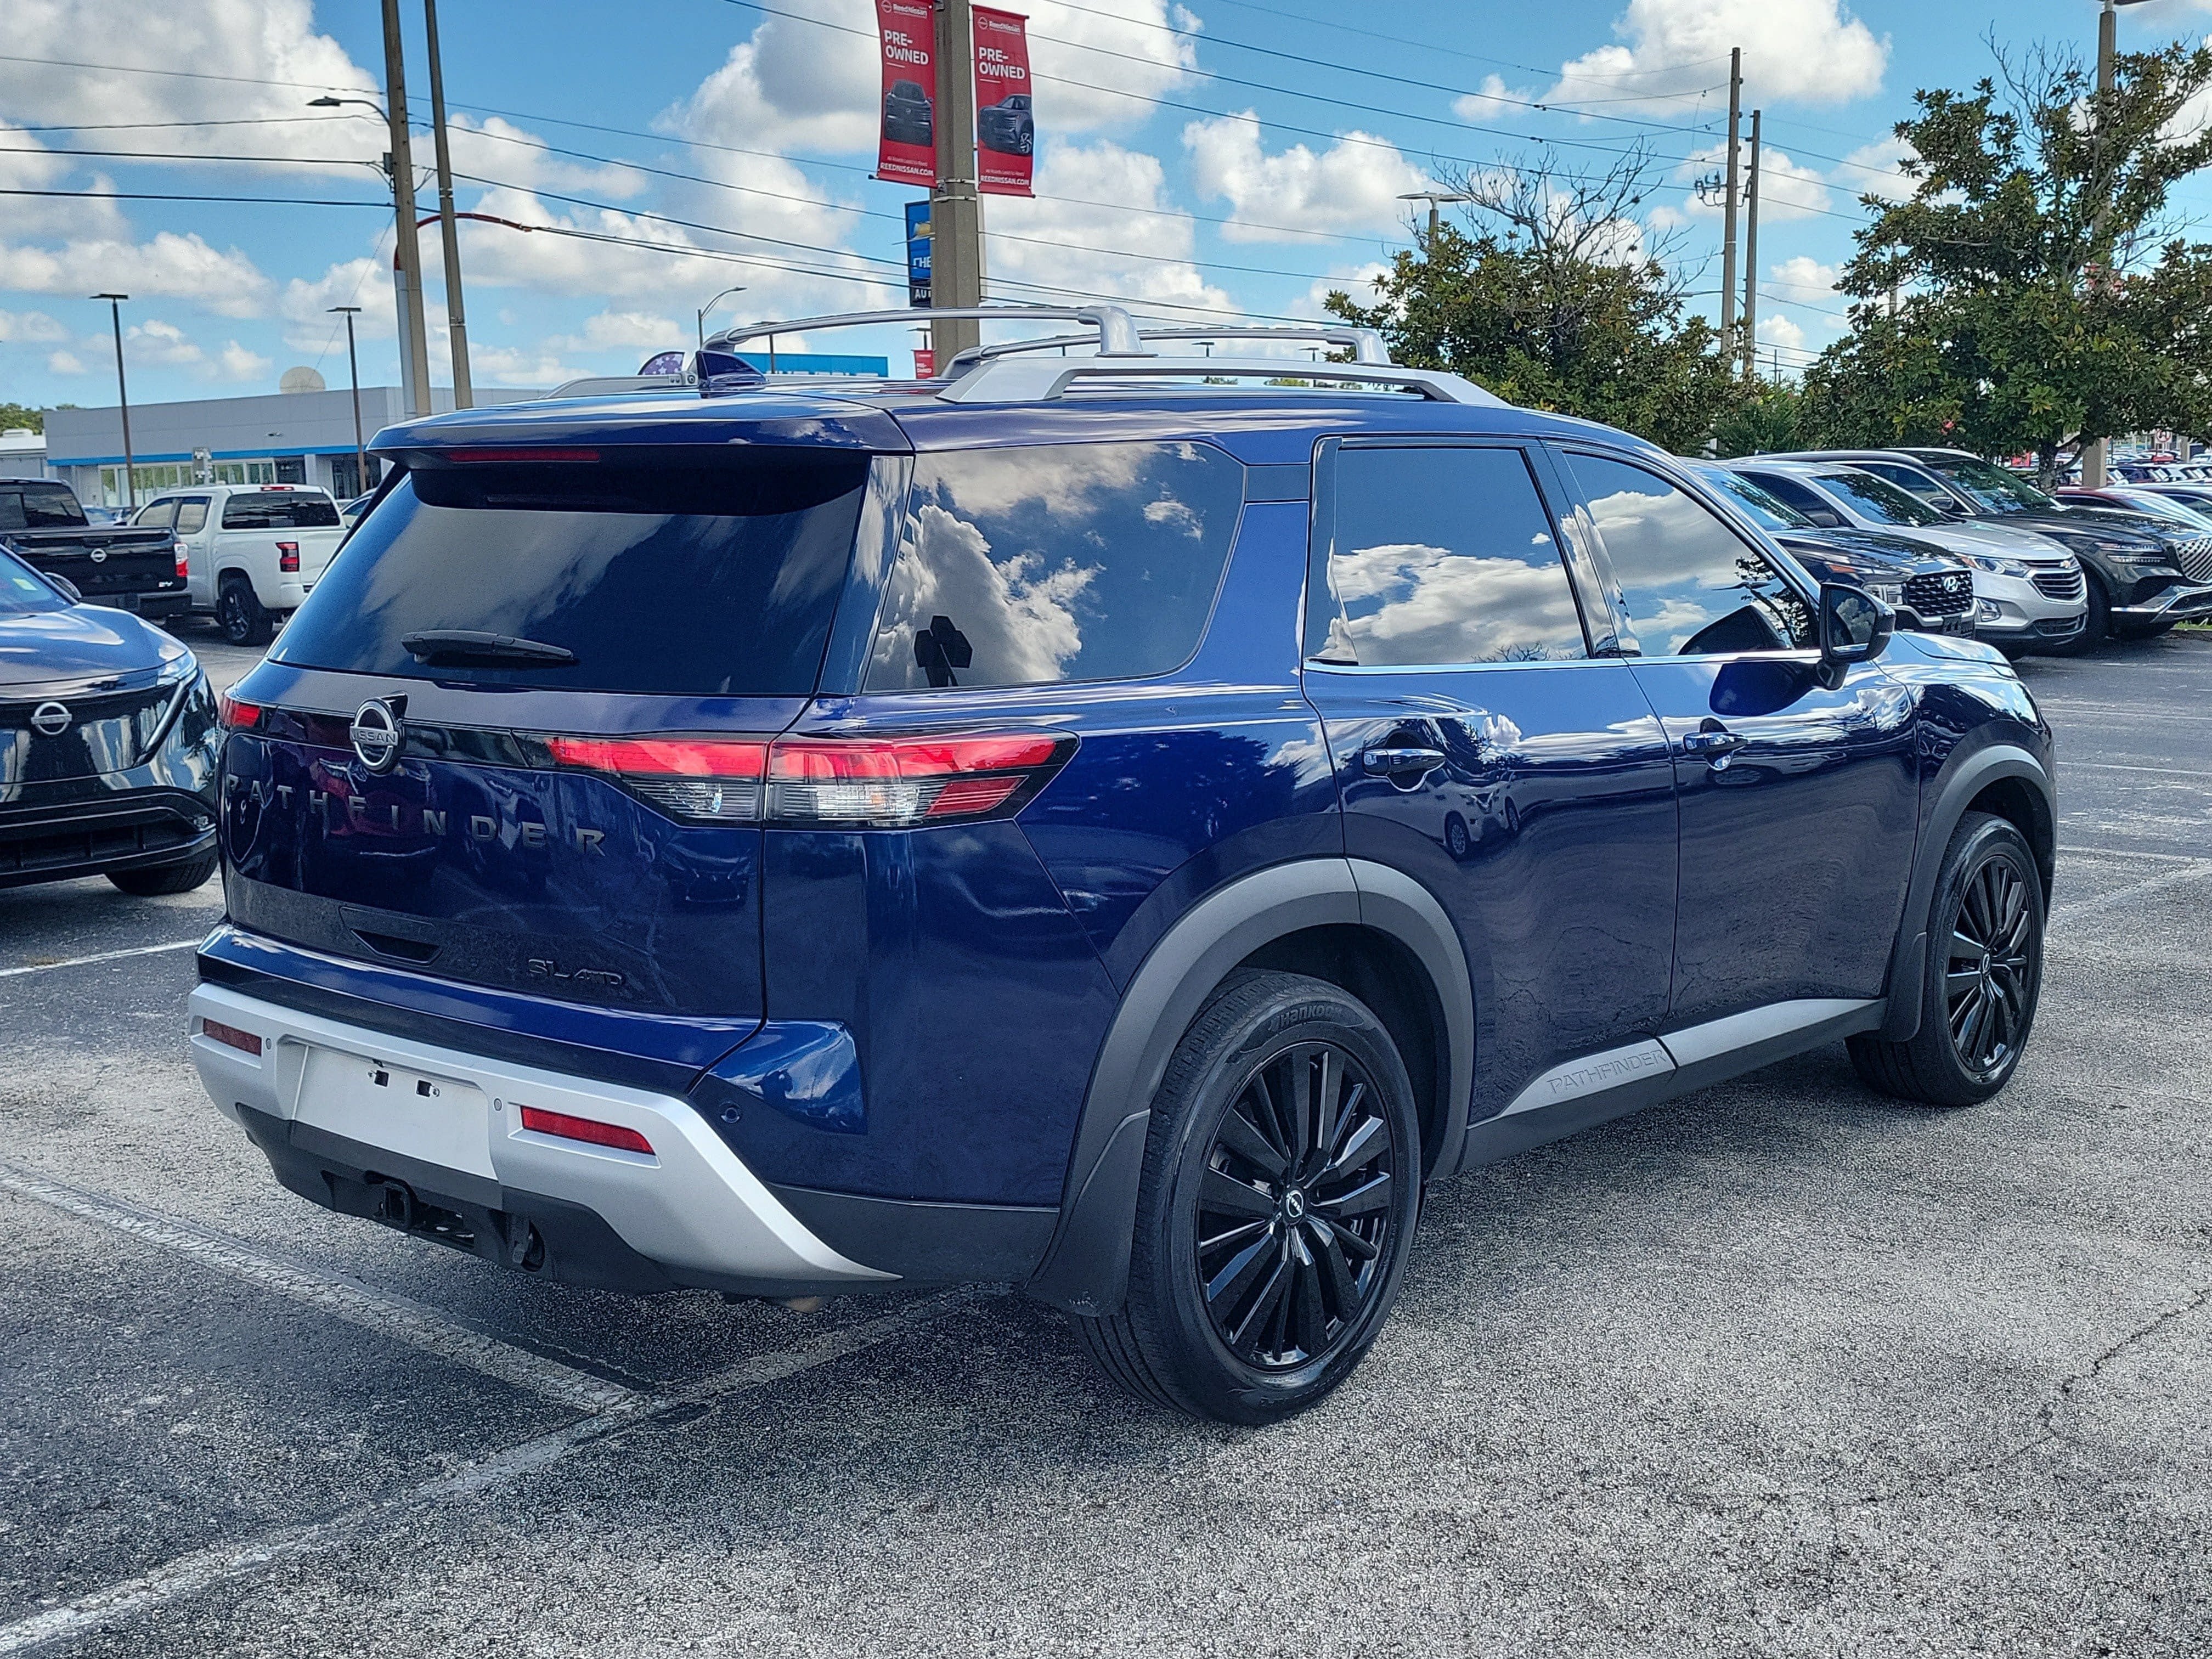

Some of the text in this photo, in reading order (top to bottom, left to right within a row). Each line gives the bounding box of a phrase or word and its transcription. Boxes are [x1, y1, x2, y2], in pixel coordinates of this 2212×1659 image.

[884, 30, 913, 47] PRE-
[885, 45, 929, 65] OWNED
[979, 47, 1008, 63] PRE-
[979, 62, 1025, 80] OWNED
[350, 727, 397, 745] NISSAN
[225, 774, 606, 856] PATHFINDER
[528, 959, 570, 978] SL
[1547, 1049, 1667, 1094] PATHFINDER
